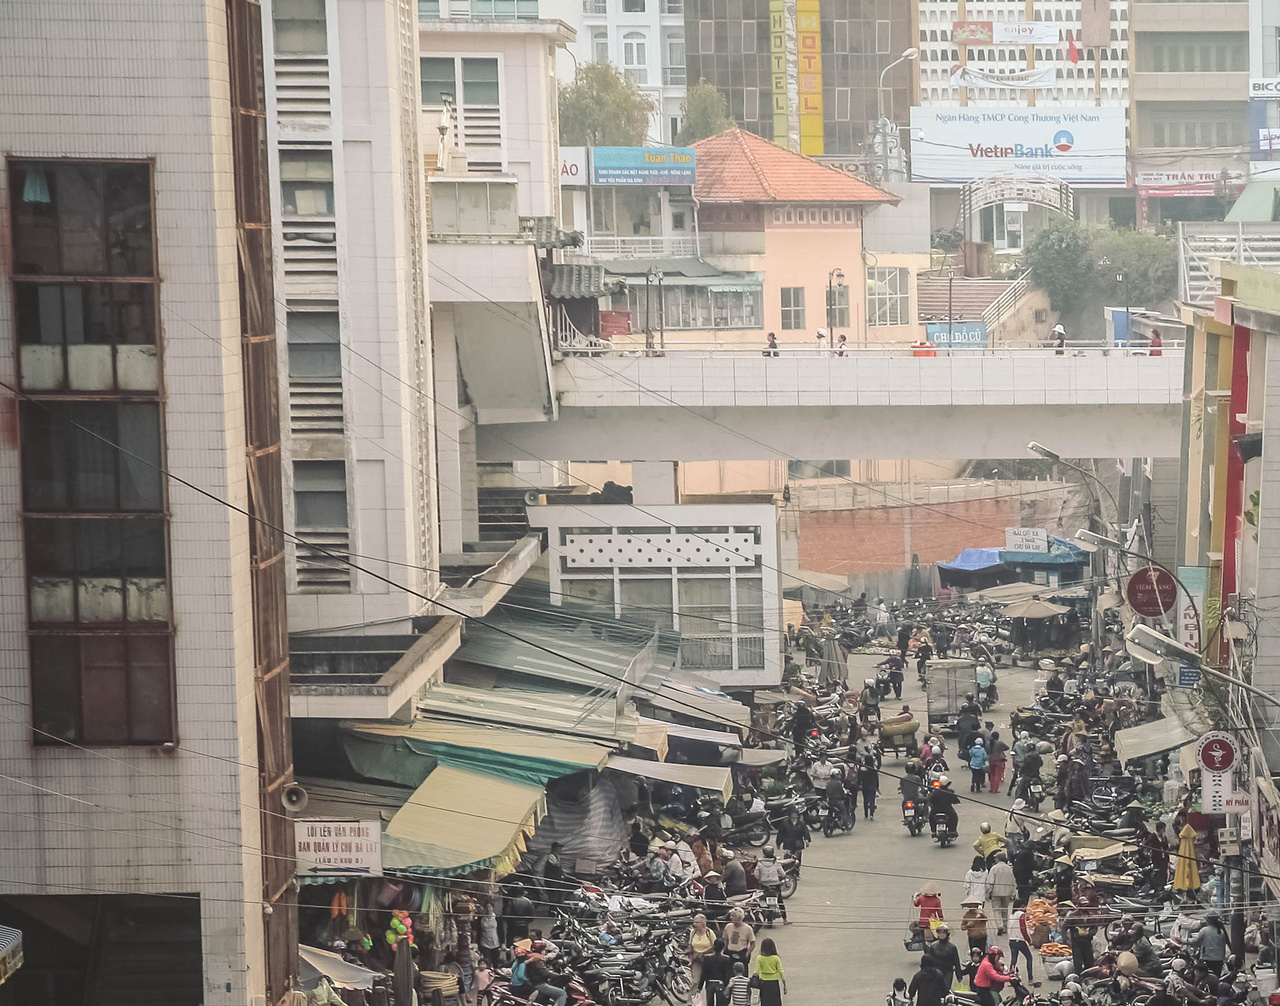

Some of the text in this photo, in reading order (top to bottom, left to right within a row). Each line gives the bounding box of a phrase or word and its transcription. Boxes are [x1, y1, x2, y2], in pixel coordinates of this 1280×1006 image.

[1004, 25, 1034, 34] enjoy
[773, 15, 784, 110] HOTEL
[801, 15, 818, 110] HOTEL
[1253, 83, 1274, 91] BIC
[936, 114, 957, 124] Ngân
[959, 114, 980, 124] Hàng
[1063, 114, 1079, 124] Việt
[968, 142, 1054, 158] VietinBank
[299, 842, 310, 852] BAN
